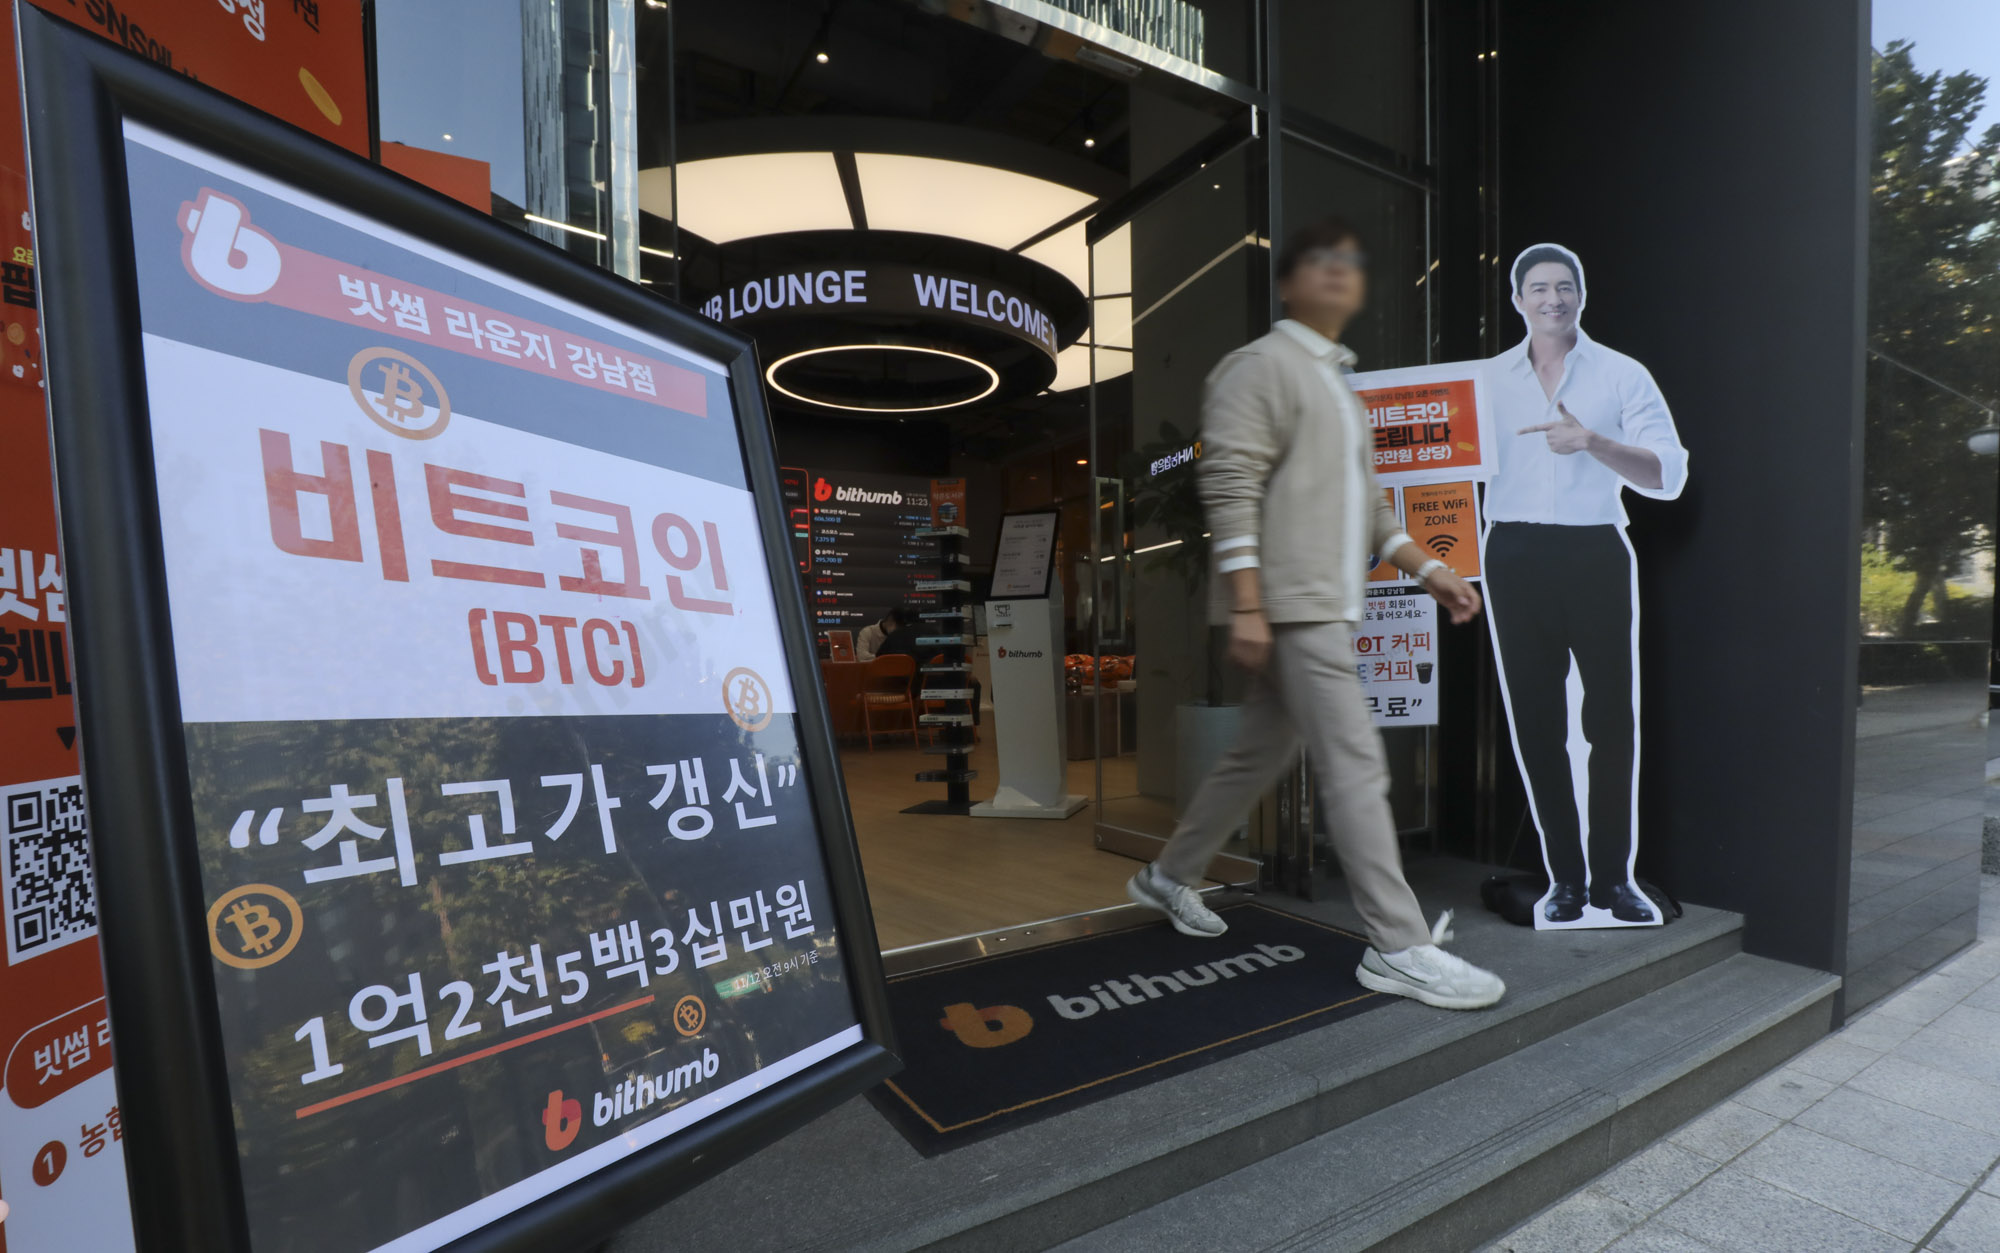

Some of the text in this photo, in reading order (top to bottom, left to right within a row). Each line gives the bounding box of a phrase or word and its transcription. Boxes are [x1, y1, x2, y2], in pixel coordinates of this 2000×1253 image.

[729, 269, 868, 320] LOUNGE
[912, 273, 1050, 347] WELCOME
[338, 273, 658, 397] 빗썸 라운지 강남점
[1365, 401, 1449, 427] 비트코인
[1417, 445, 1452, 462] 상당)
[836, 486, 903, 505] bithumb
[1412, 498, 1468, 513] FREE WiFi
[259, 428, 735, 616] 비트코인
[1424, 514, 1458, 526] ZONE
[1388, 599, 1416, 609] 회원이
[468, 608, 645, 688] (BTC)
[1008, 650, 1043, 659] bithumb
[1352, 631, 1431, 653] OT 커피
[1375, 660, 1413, 681] 커피
[762, 961, 783, 980] 오전
[783, 955, 800, 973] 9시
[800, 949, 819, 967] 기준
[1047, 943, 1306, 1020] bithumb
[34, 1024, 91, 1086] 빗썸
[593, 1047, 720, 1127] bithumb
